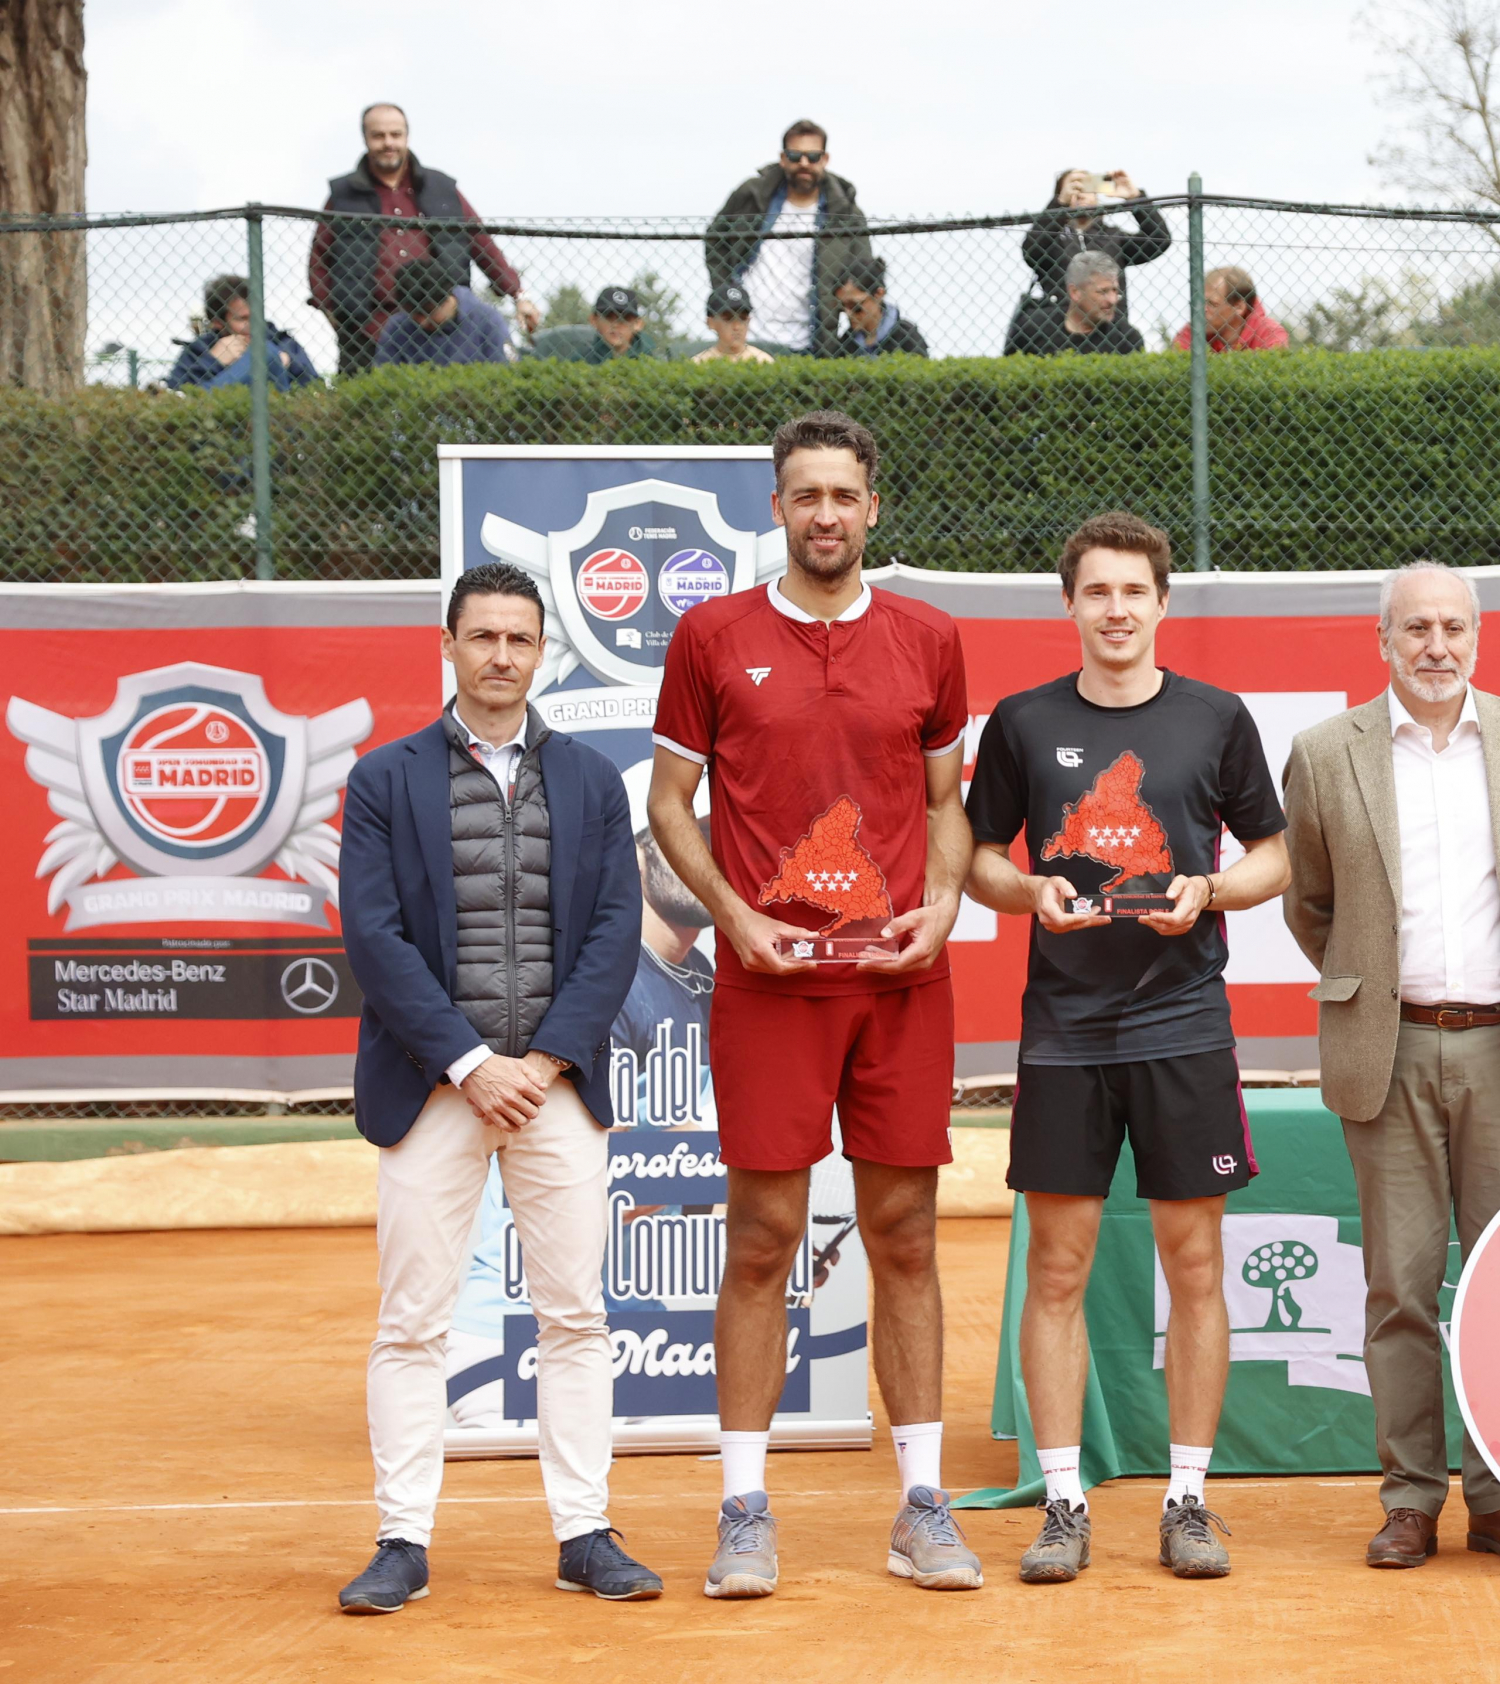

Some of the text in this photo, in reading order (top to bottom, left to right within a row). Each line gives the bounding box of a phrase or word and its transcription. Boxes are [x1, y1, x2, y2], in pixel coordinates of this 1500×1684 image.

[596, 581, 643, 591] MADRID
[676, 581, 722, 591] MADRID
[548, 698, 659, 722] GRAND PRI
[158, 768, 255, 786] MADRID
[83, 888, 312, 914] GRAND PRIX MADRID
[161, 938, 212, 947] Patrocinado
[54, 959, 227, 983] Mercedes-Benz
[57, 987, 179, 1012] Star Madrid
[646, 1023, 703, 1126] del
